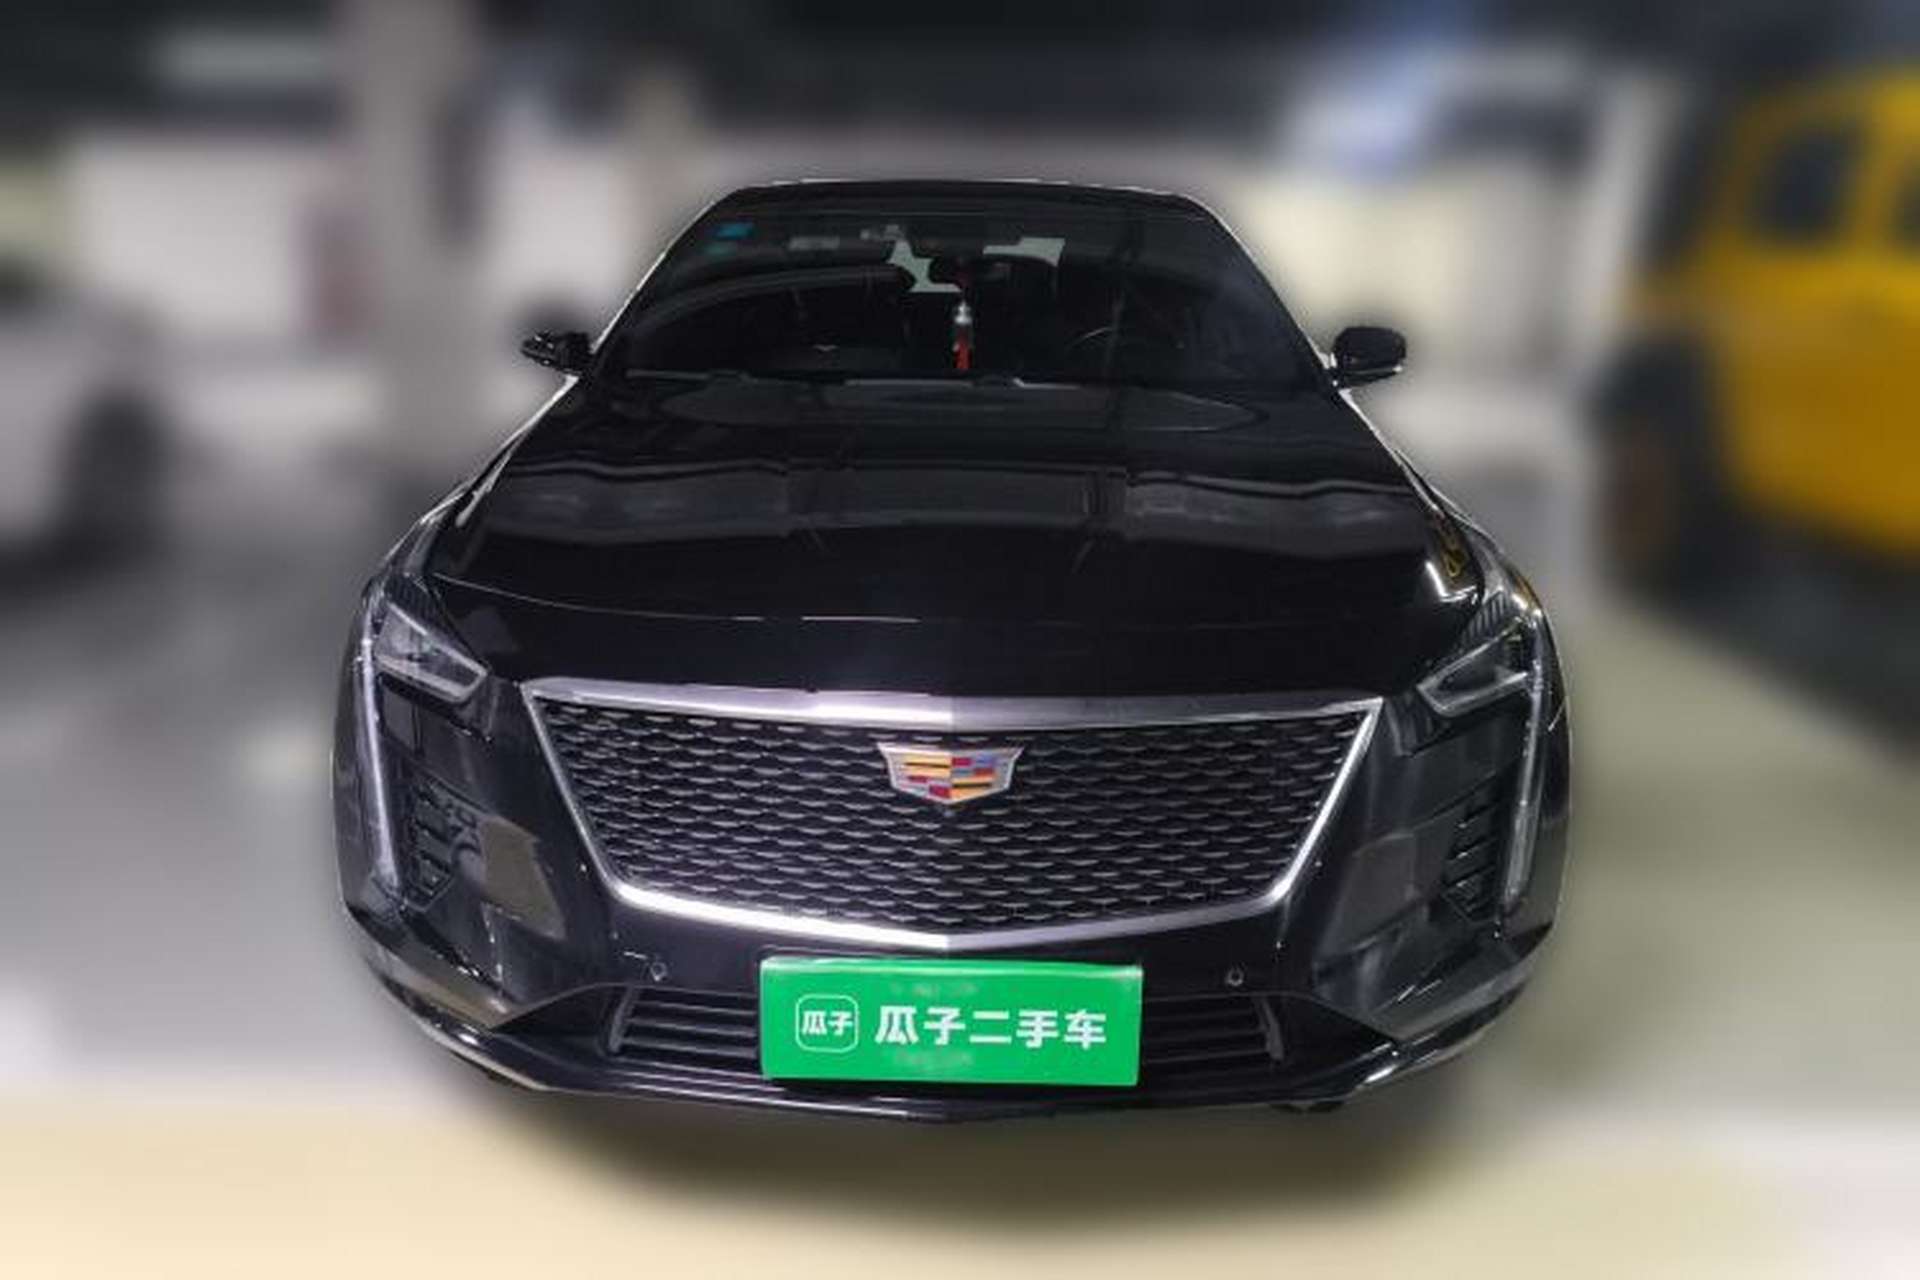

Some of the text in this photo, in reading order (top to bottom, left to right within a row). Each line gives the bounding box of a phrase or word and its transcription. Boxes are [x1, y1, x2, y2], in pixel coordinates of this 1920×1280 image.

[802, 1010, 853, 1036] 瓜子
[875, 1006, 1106, 1049] 瓜子二手车
